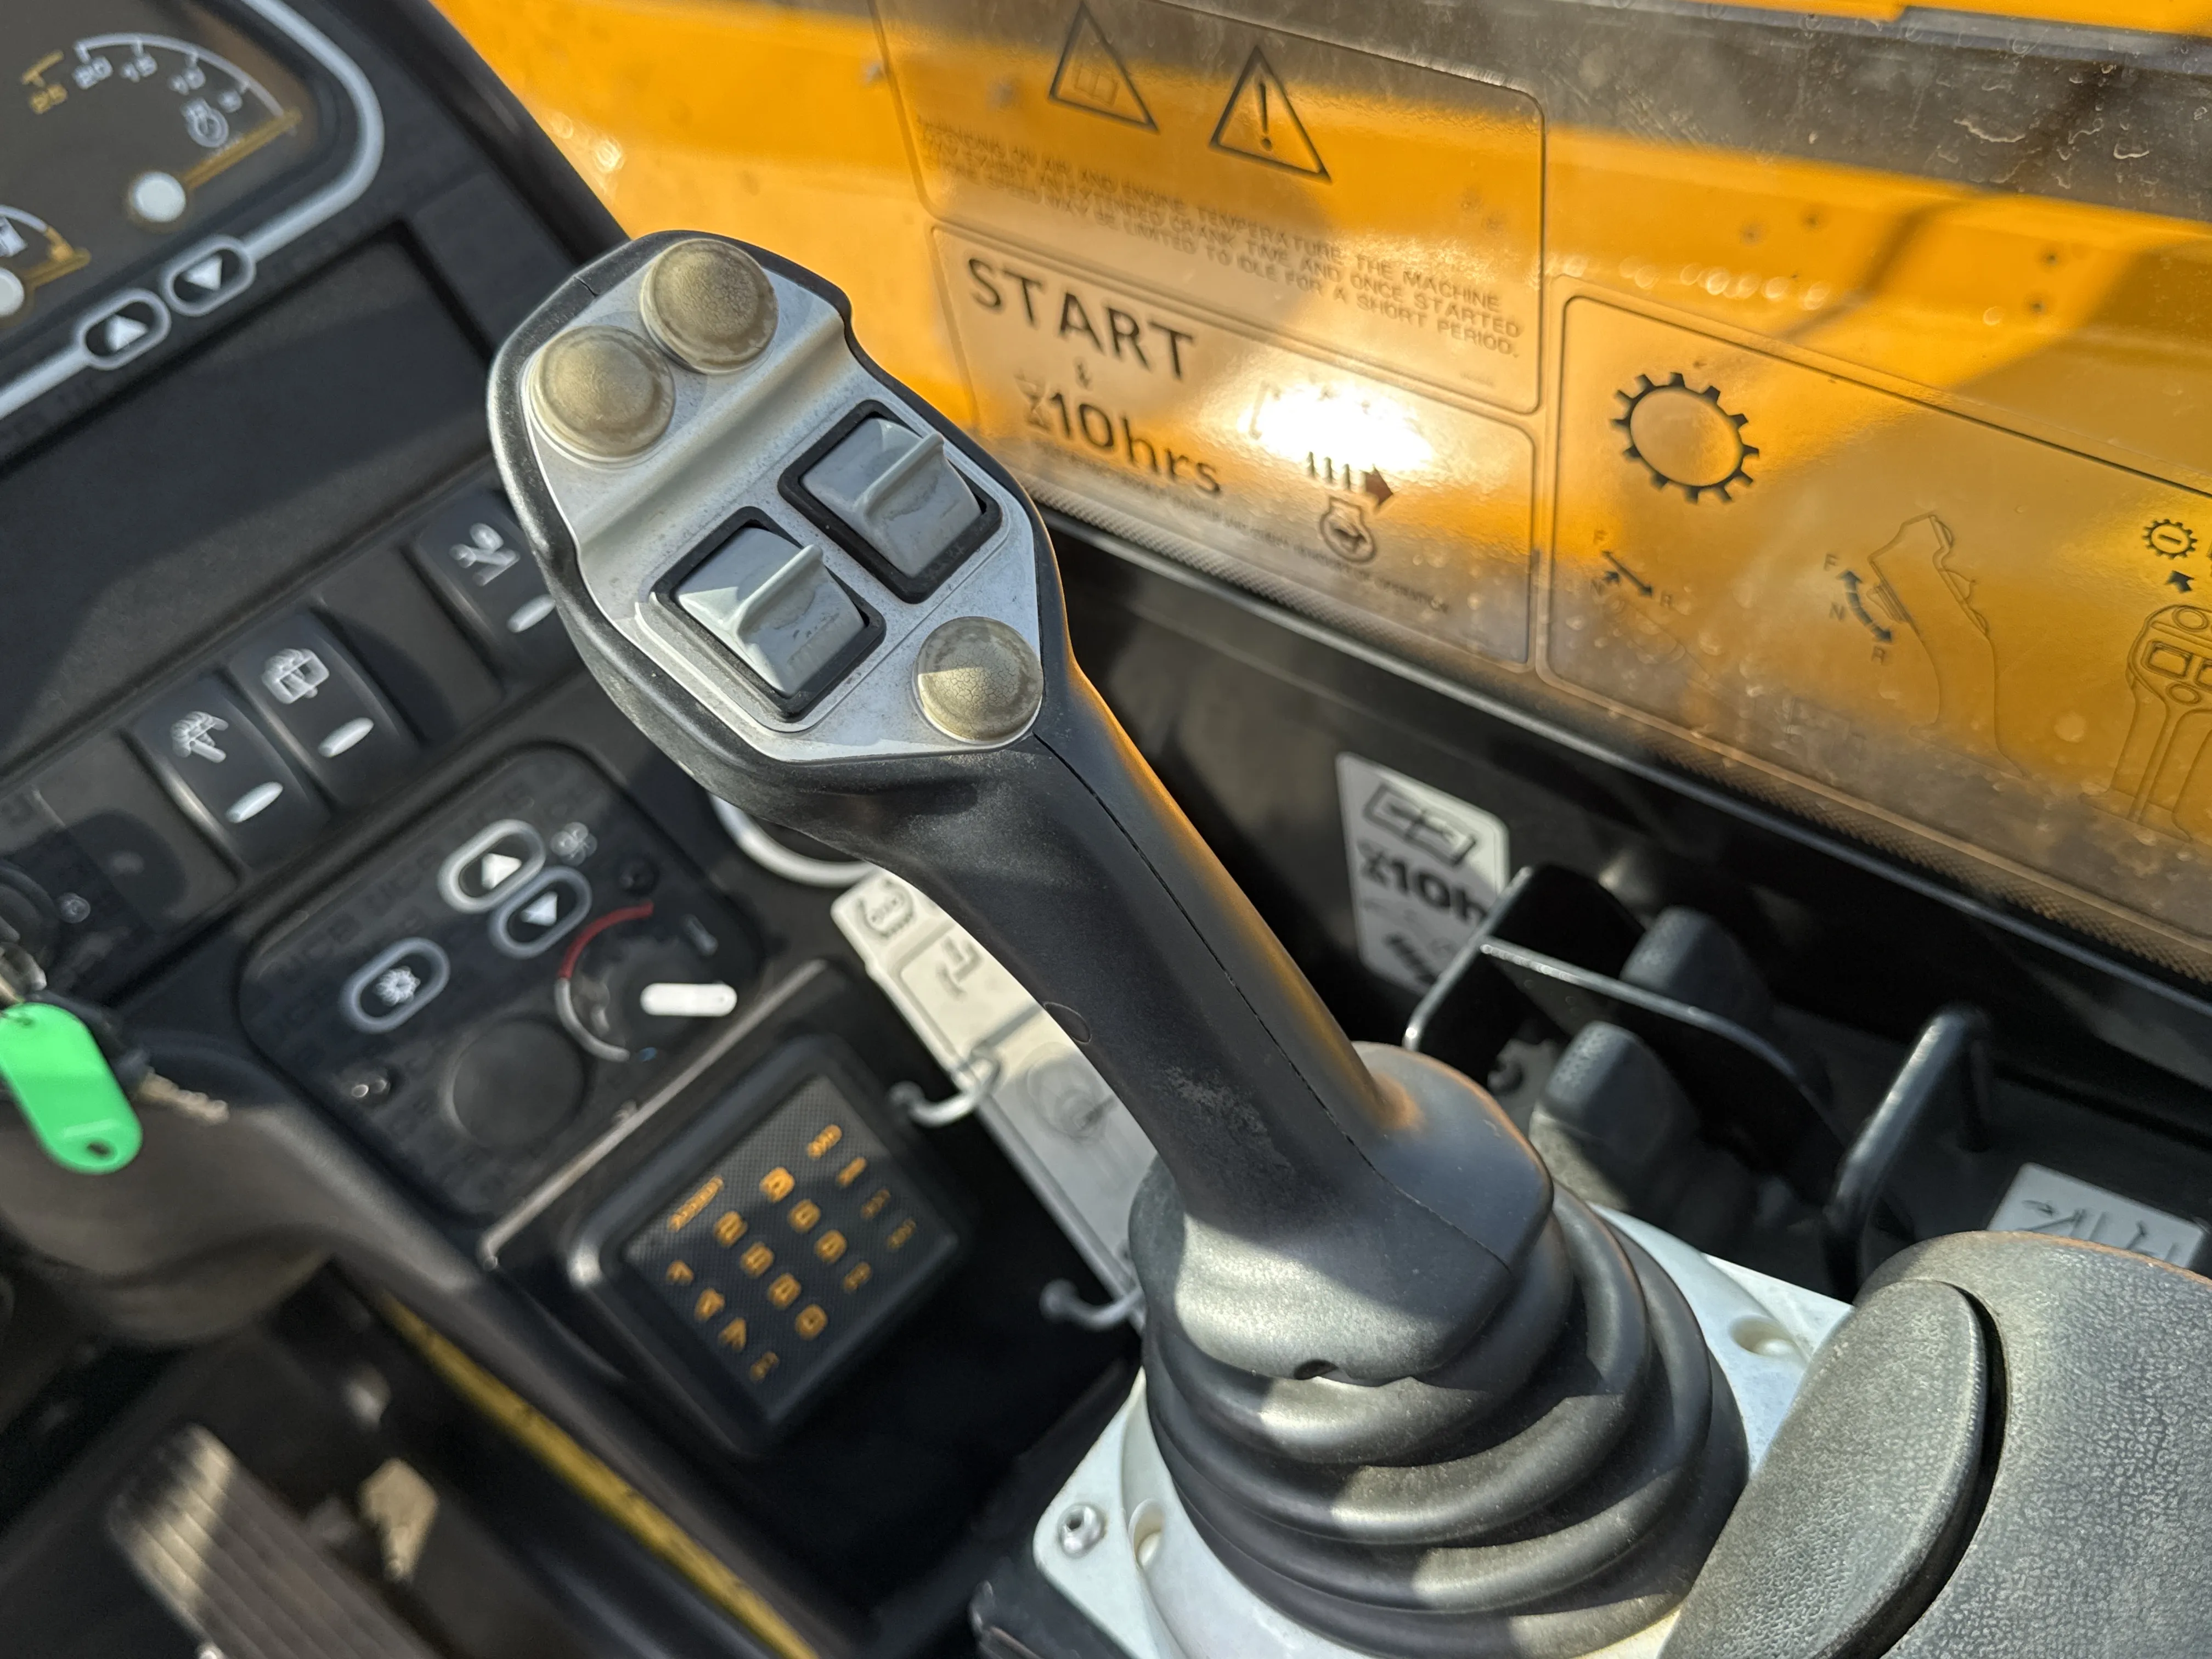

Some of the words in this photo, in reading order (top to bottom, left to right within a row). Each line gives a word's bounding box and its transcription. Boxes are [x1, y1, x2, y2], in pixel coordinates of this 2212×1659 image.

[968, 257, 1195, 380] START
[1286, 268, 1325, 297] FOR
[1333, 286, 1349, 304] A
[1356, 293, 1427, 328] SHORT
[1437, 317, 1519, 358] PERIOD.
[1302, 258, 1343, 284] AND
[1350, 273, 1403, 303] ONCE
[1413, 291, 1523, 338] STARTED
[1356, 253, 1394, 276] THE
[1402, 270, 1500, 313] MACHINE
[1048, 392, 1221, 494] 10hrs
[1823, 553, 1839, 571] F
[1871, 645, 1886, 665] R
